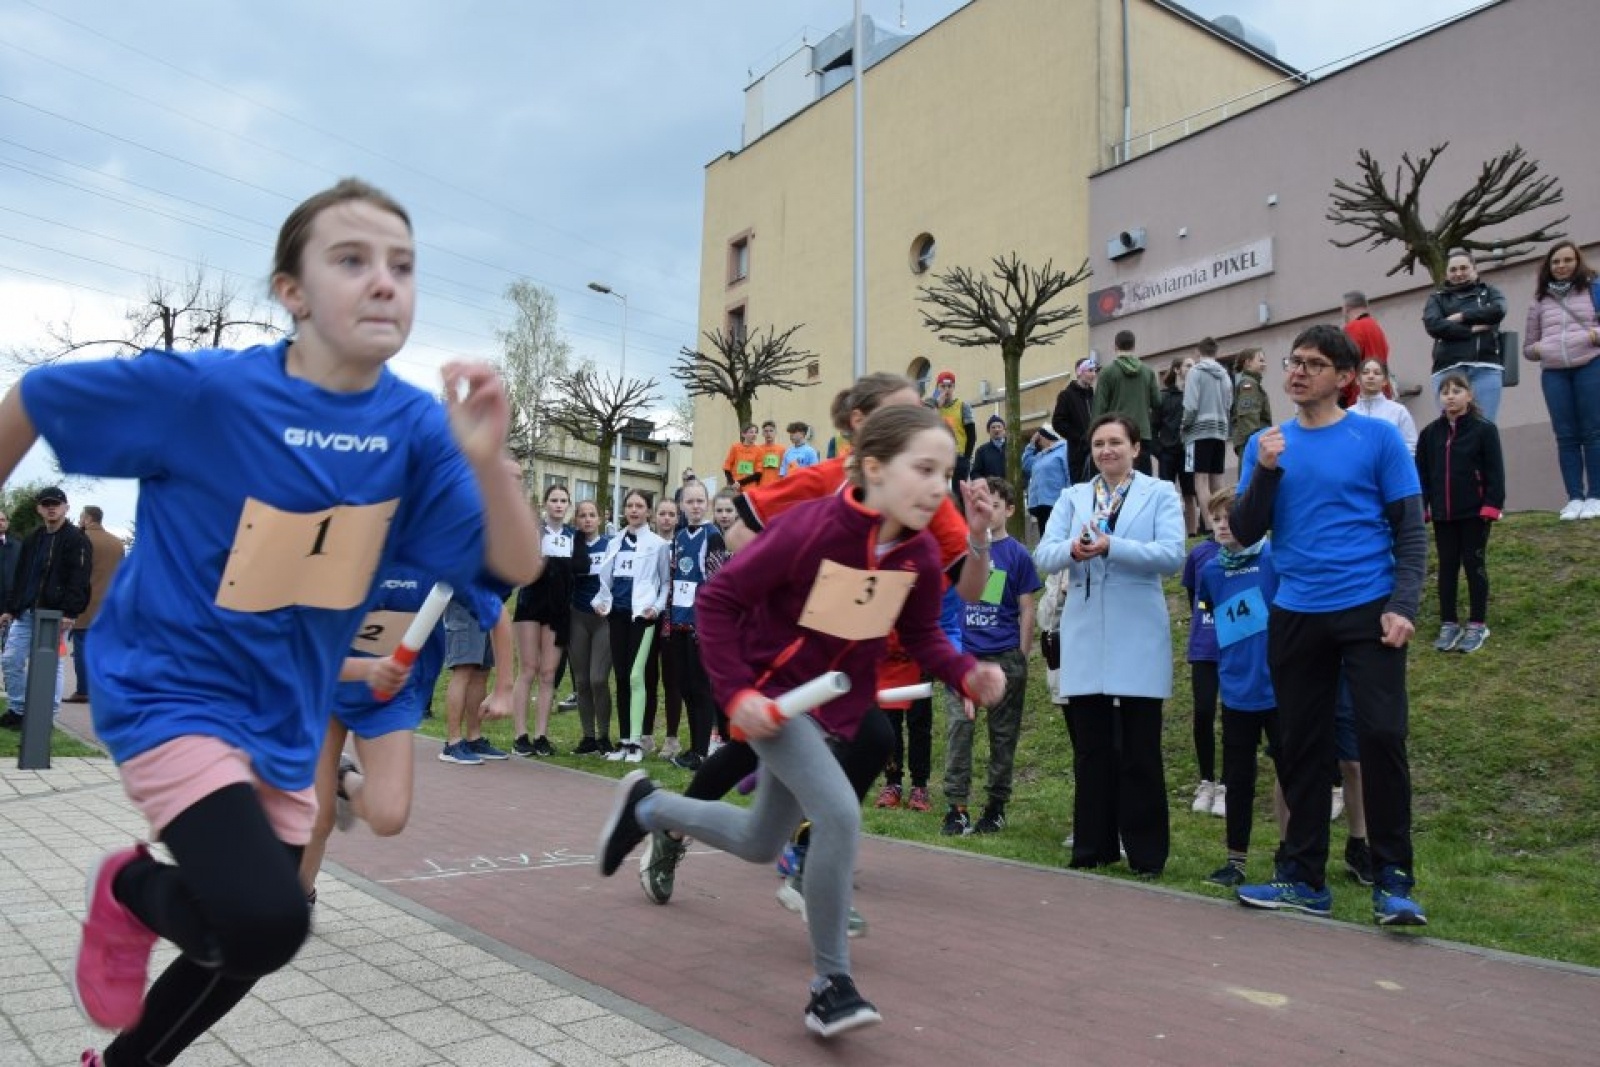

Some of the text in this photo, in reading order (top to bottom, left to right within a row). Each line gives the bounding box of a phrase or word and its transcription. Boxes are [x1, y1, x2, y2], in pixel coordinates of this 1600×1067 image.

[1132, 251, 1259, 302] Kawiarnia PIXEL
[283, 427, 388, 452] GIVOVA
[305, 515, 333, 558] 1
[855, 576, 878, 606] 3
[1226, 599, 1250, 623] 14
[359, 625, 385, 641] 2
